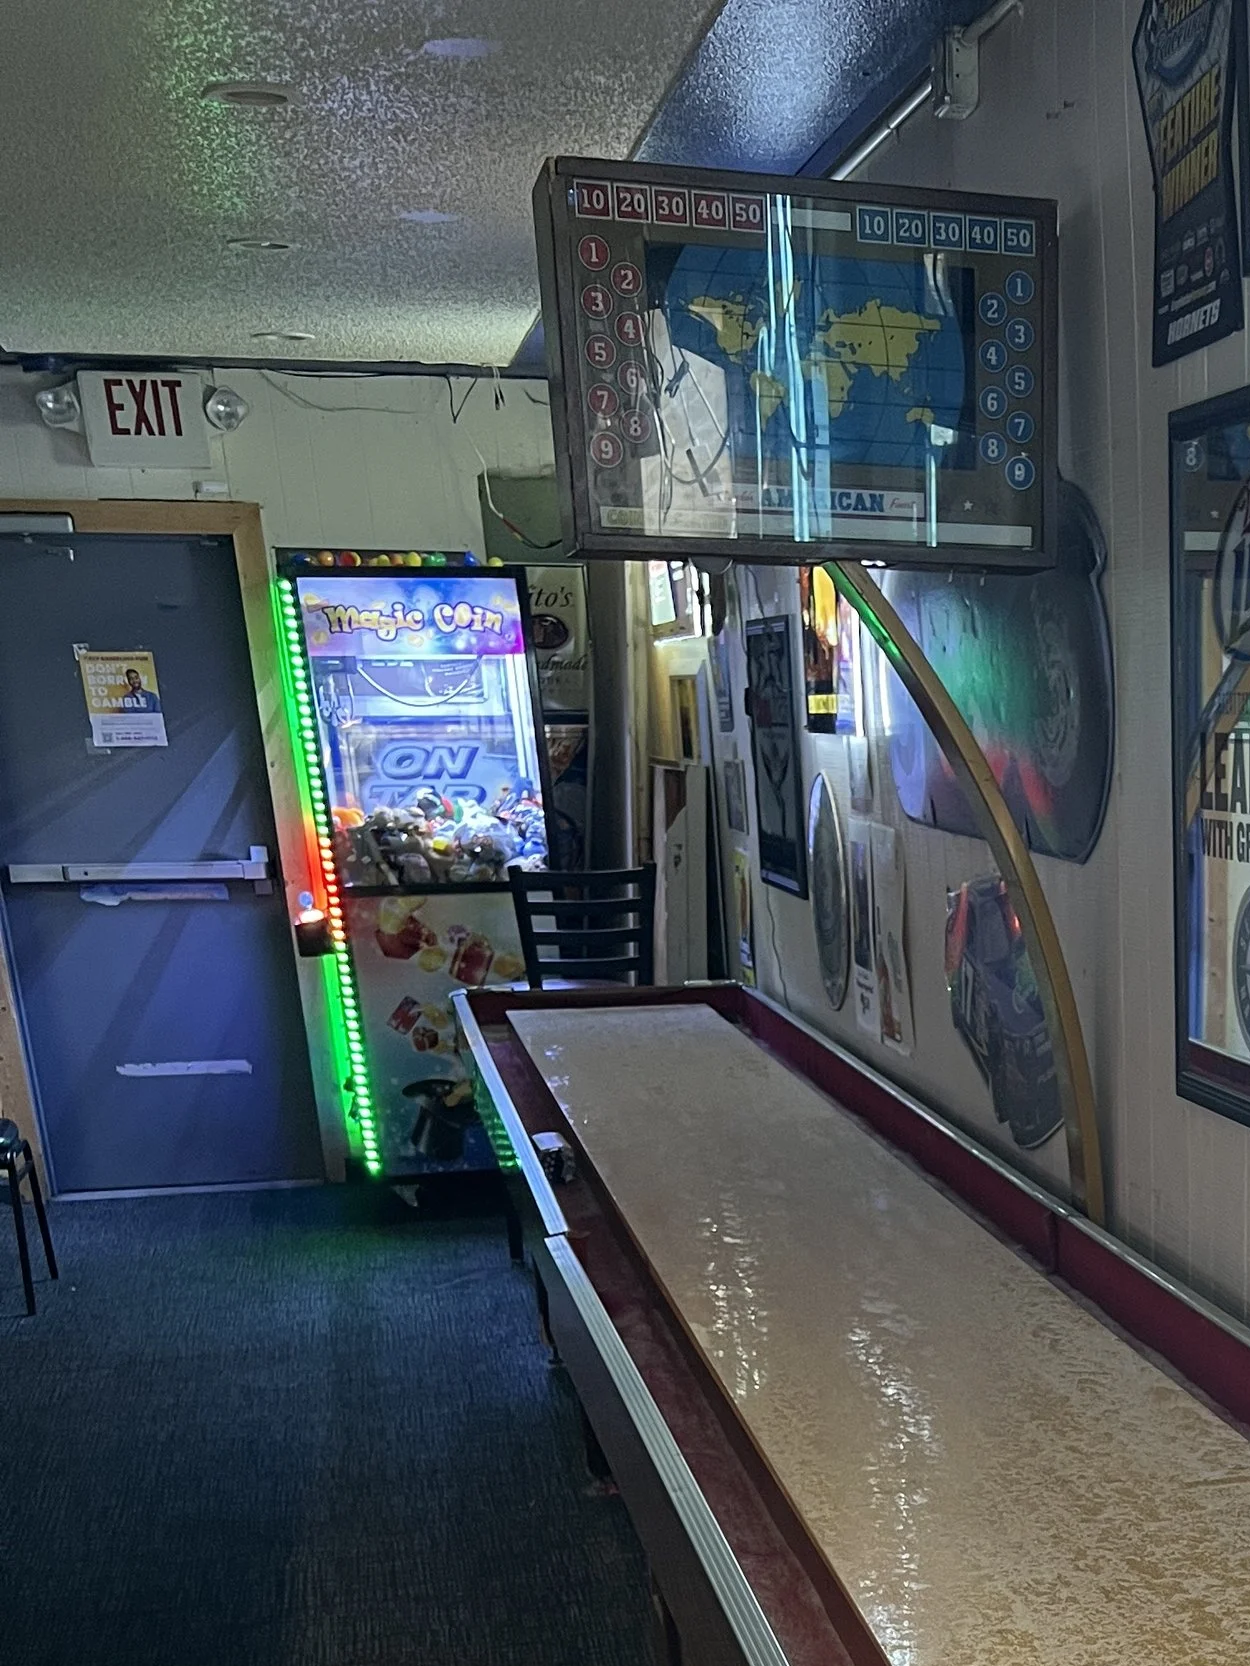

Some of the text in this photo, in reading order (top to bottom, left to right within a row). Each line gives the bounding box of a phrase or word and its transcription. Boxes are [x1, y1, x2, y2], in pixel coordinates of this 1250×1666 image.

[581, 188, 761, 224] 10 20 30 40 50
[864, 215, 1031, 248] 10 20 30 40 50
[103, 378, 183, 436] EXIT
[322, 601, 424, 641] Magic
[90, 686, 108, 696] TO
[92, 697, 147, 708] GAMBLE
[381, 745, 480, 780] ON
[1201, 818, 1233, 861] WITH
